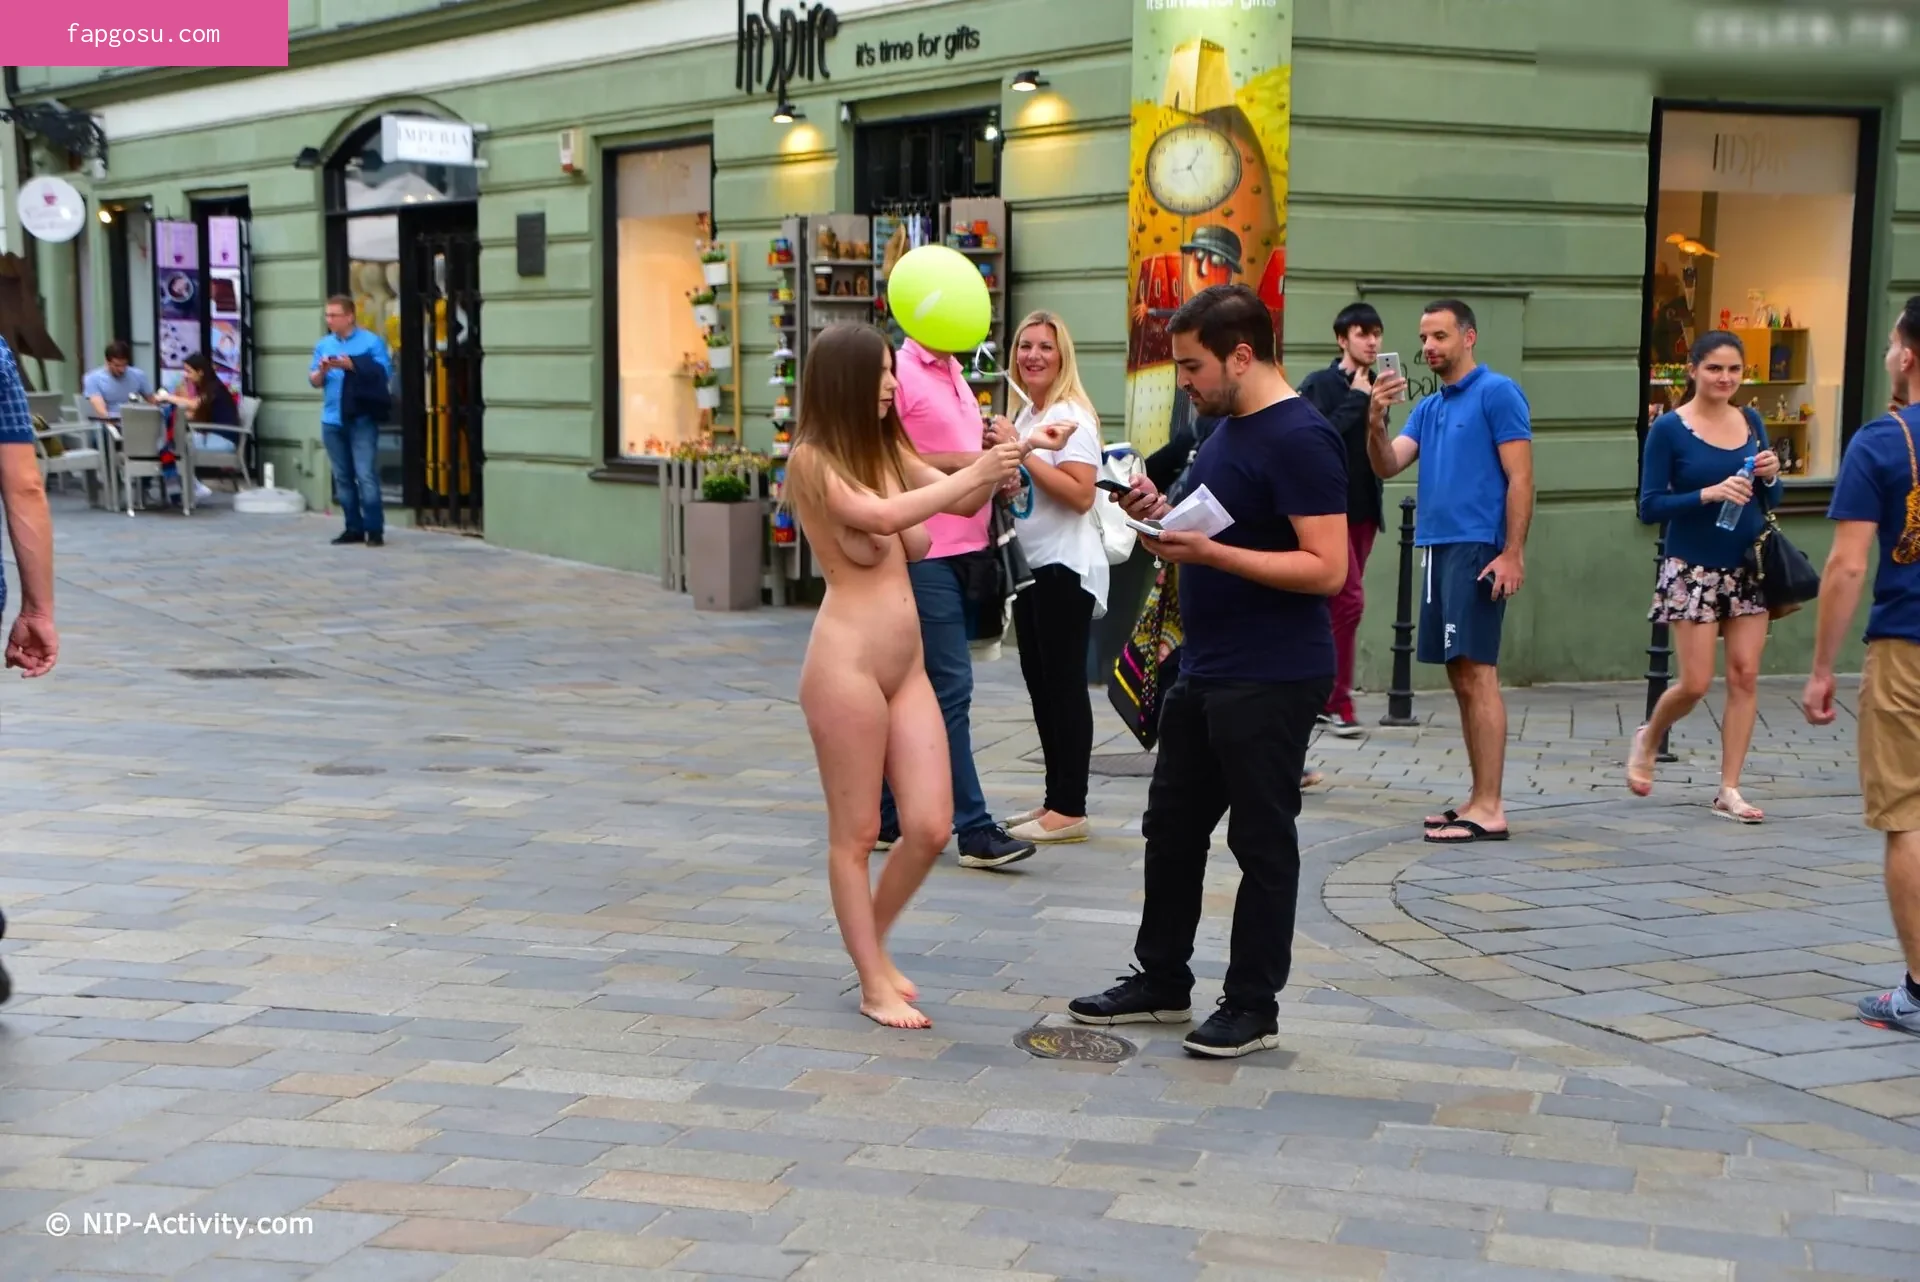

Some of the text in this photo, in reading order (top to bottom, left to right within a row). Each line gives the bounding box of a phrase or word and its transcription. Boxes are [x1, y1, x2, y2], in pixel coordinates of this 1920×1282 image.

[855, 24, 980, 68] it's time for gifts
